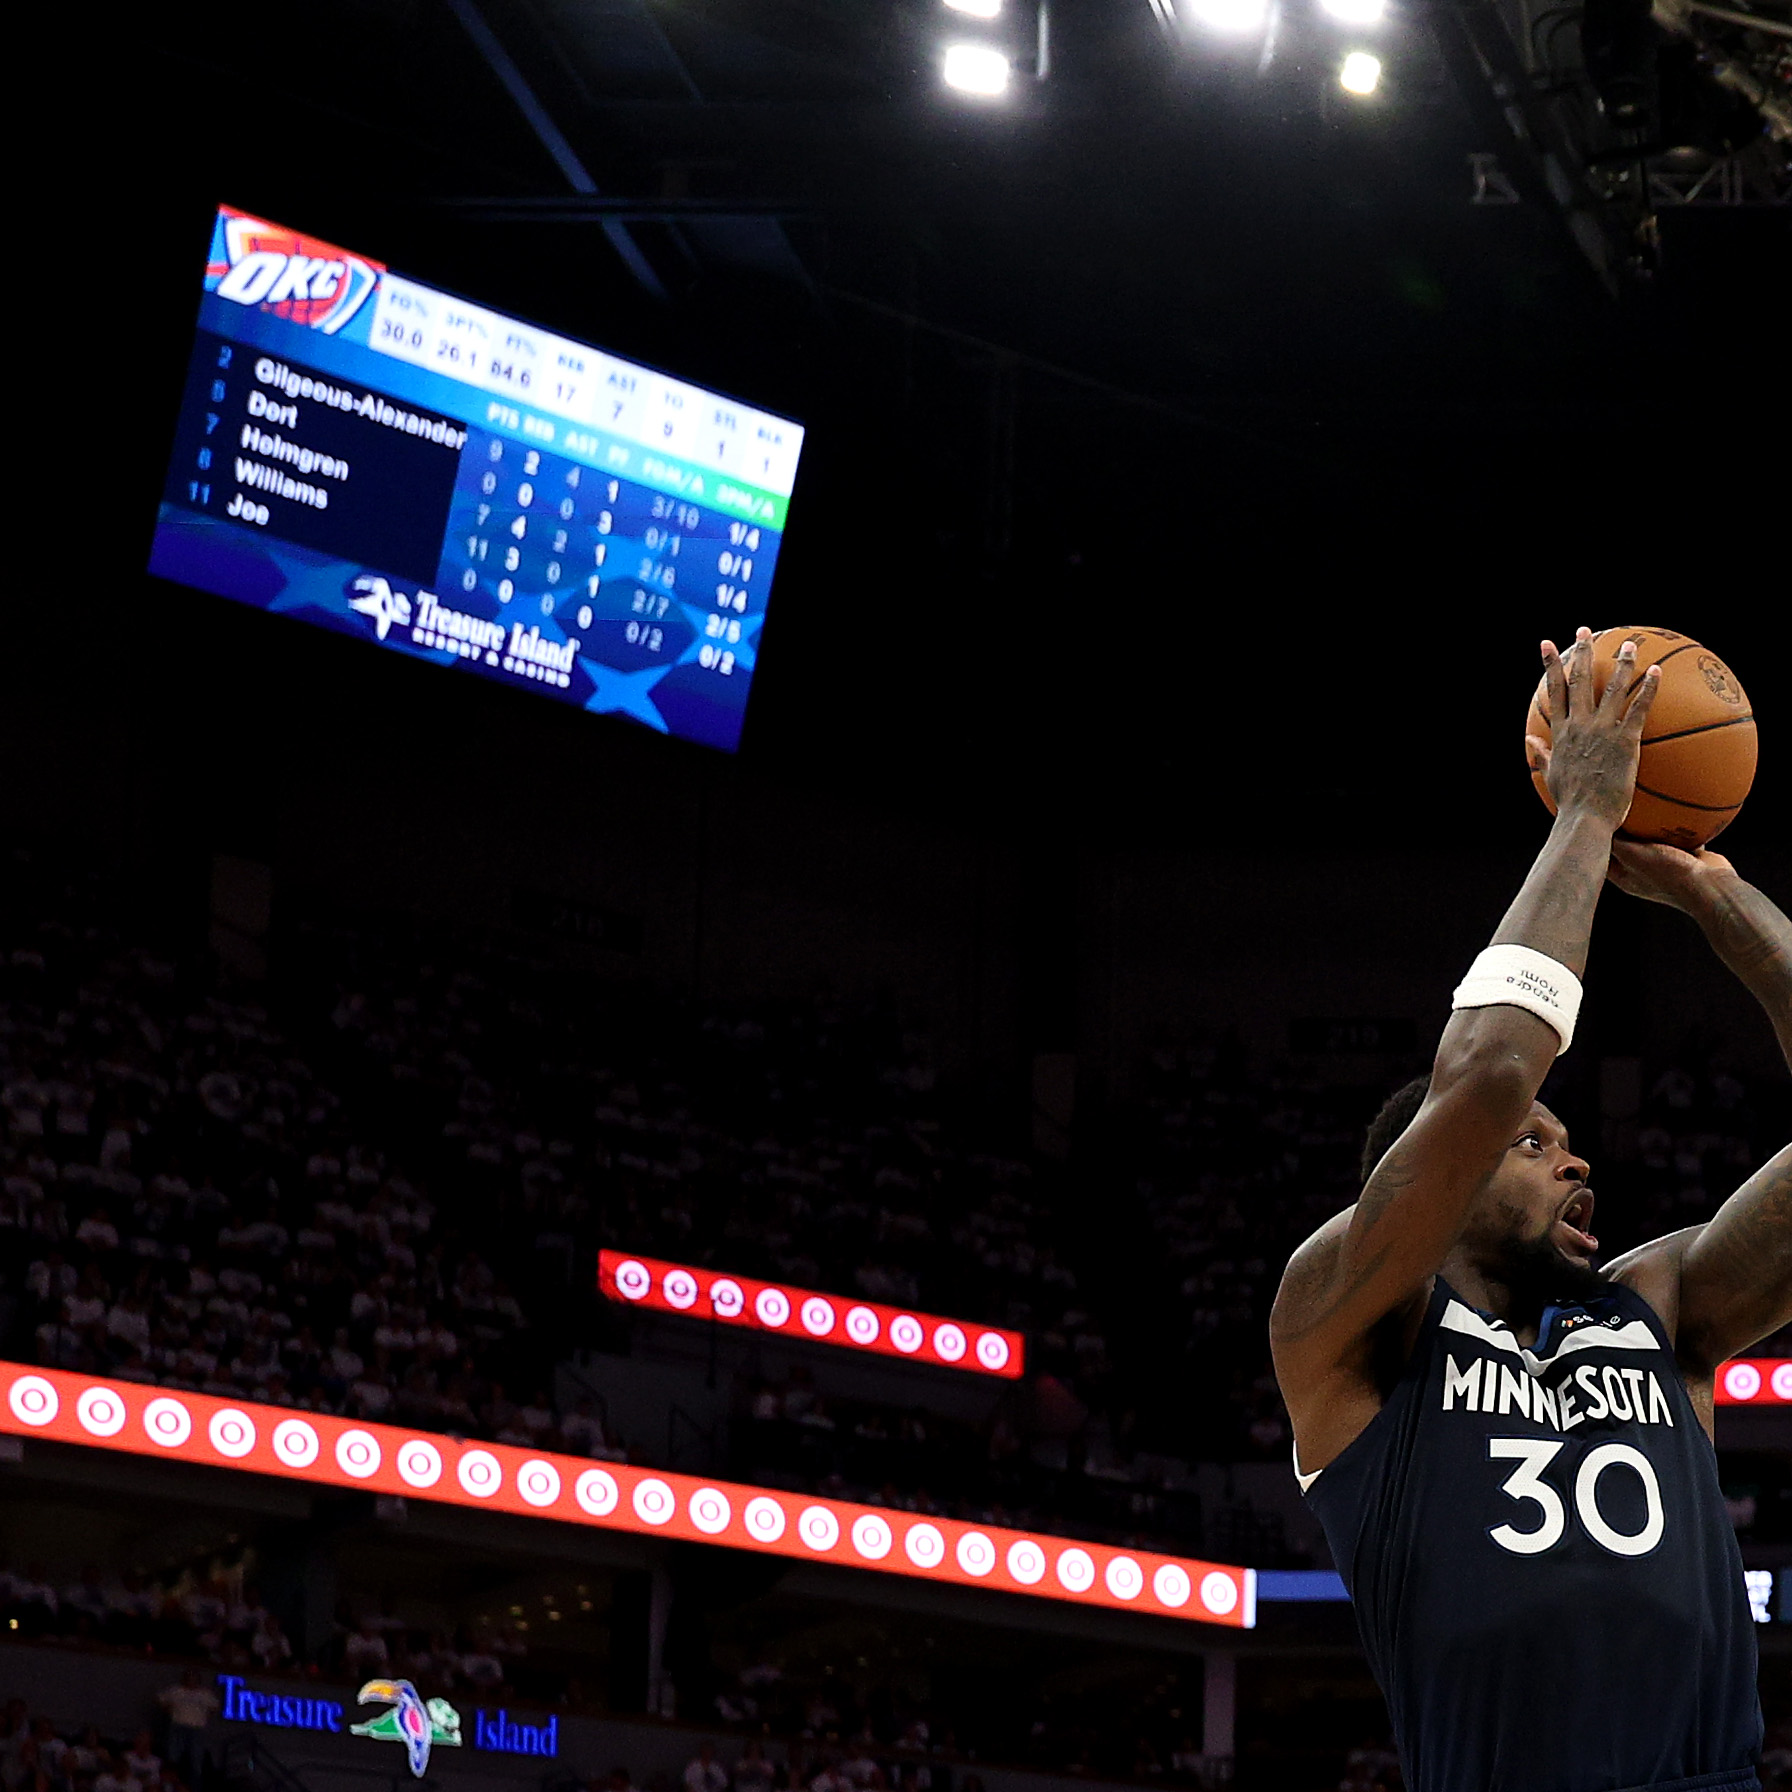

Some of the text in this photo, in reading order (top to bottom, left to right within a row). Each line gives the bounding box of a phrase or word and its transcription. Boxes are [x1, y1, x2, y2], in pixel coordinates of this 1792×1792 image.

[218, 250, 347, 303] OKC
[247, 389, 298, 428] Dort
[481, 471, 496, 494] 0
[517, 482, 533, 507] 0
[597, 510, 612, 534] 3
[717, 551, 752, 582] 0/1
[254, 357, 468, 450] Gilgeous-Alexander
[523, 450, 540, 476] 2
[607, 479, 619, 503] 1
[729, 522, 760, 551] 1/4
[553, 378, 578, 408] 17
[608, 399, 625, 425] 7
[713, 438, 727, 463] 1
[759, 455, 772, 479] 1
[235, 456, 327, 509] Williams
[468, 535, 488, 561] 11
[504, 546, 519, 571] 3
[588, 574, 599, 598] 1
[241, 423, 349, 481] Holmgren
[477, 503, 490, 526] 7
[510, 515, 526, 539] 4
[595, 543, 606, 566] 1
[716, 583, 747, 613] 1/4
[227, 492, 269, 525] Joe
[497, 578, 513, 603] 0
[577, 605, 592, 629] 0
[698, 643, 735, 675] 0/2
[410, 587, 579, 675] Treasure Island
[1442, 1354, 1674, 1432] MINNESOTA
[1488, 1437, 1666, 1559] 30
[216, 1674, 558, 1758] Treasure Island
